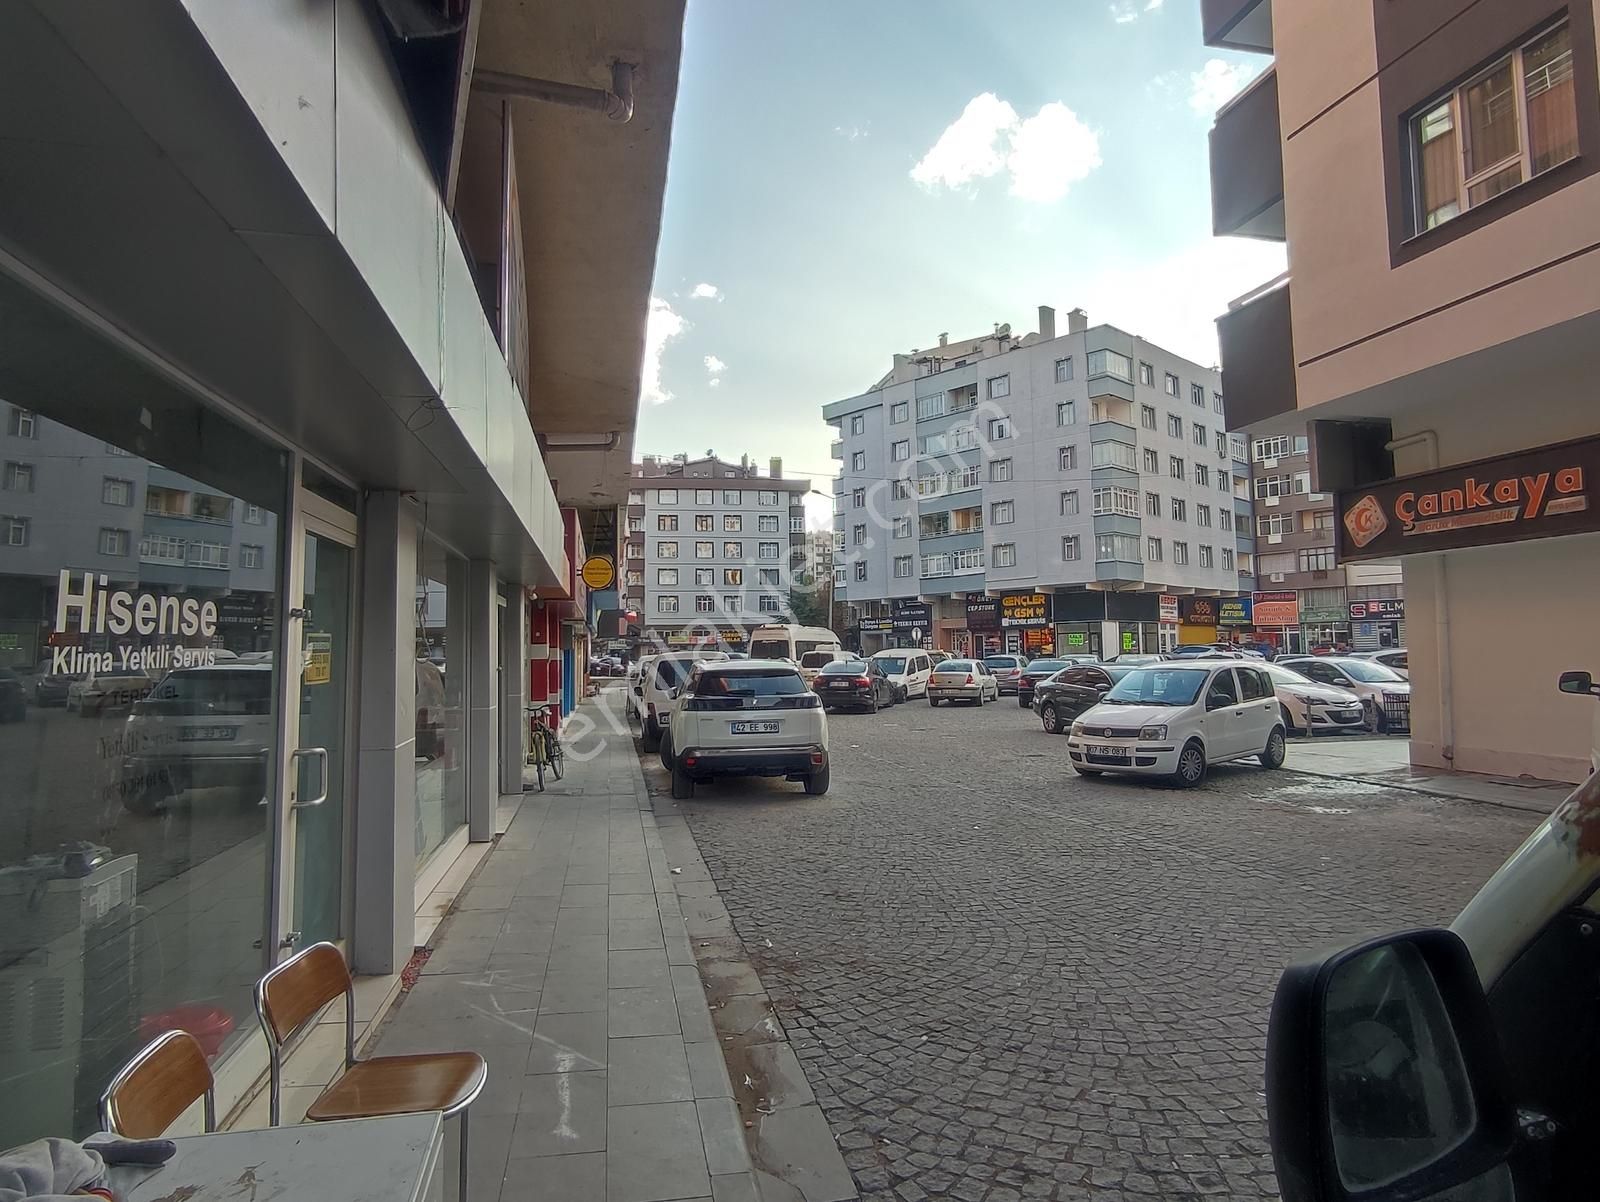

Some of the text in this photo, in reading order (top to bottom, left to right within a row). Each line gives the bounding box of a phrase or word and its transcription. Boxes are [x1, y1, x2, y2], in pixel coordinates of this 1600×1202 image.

[1395, 467, 1584, 527] Çankaya
[55, 569, 218, 637] Hisense
[1002, 594, 1046, 607] GENÇLER
[1014, 608, 1034, 618] GSM
[52, 644, 216, 675] Klima Yetkili Servis
[736, 723, 778, 732] 42 EE 998
